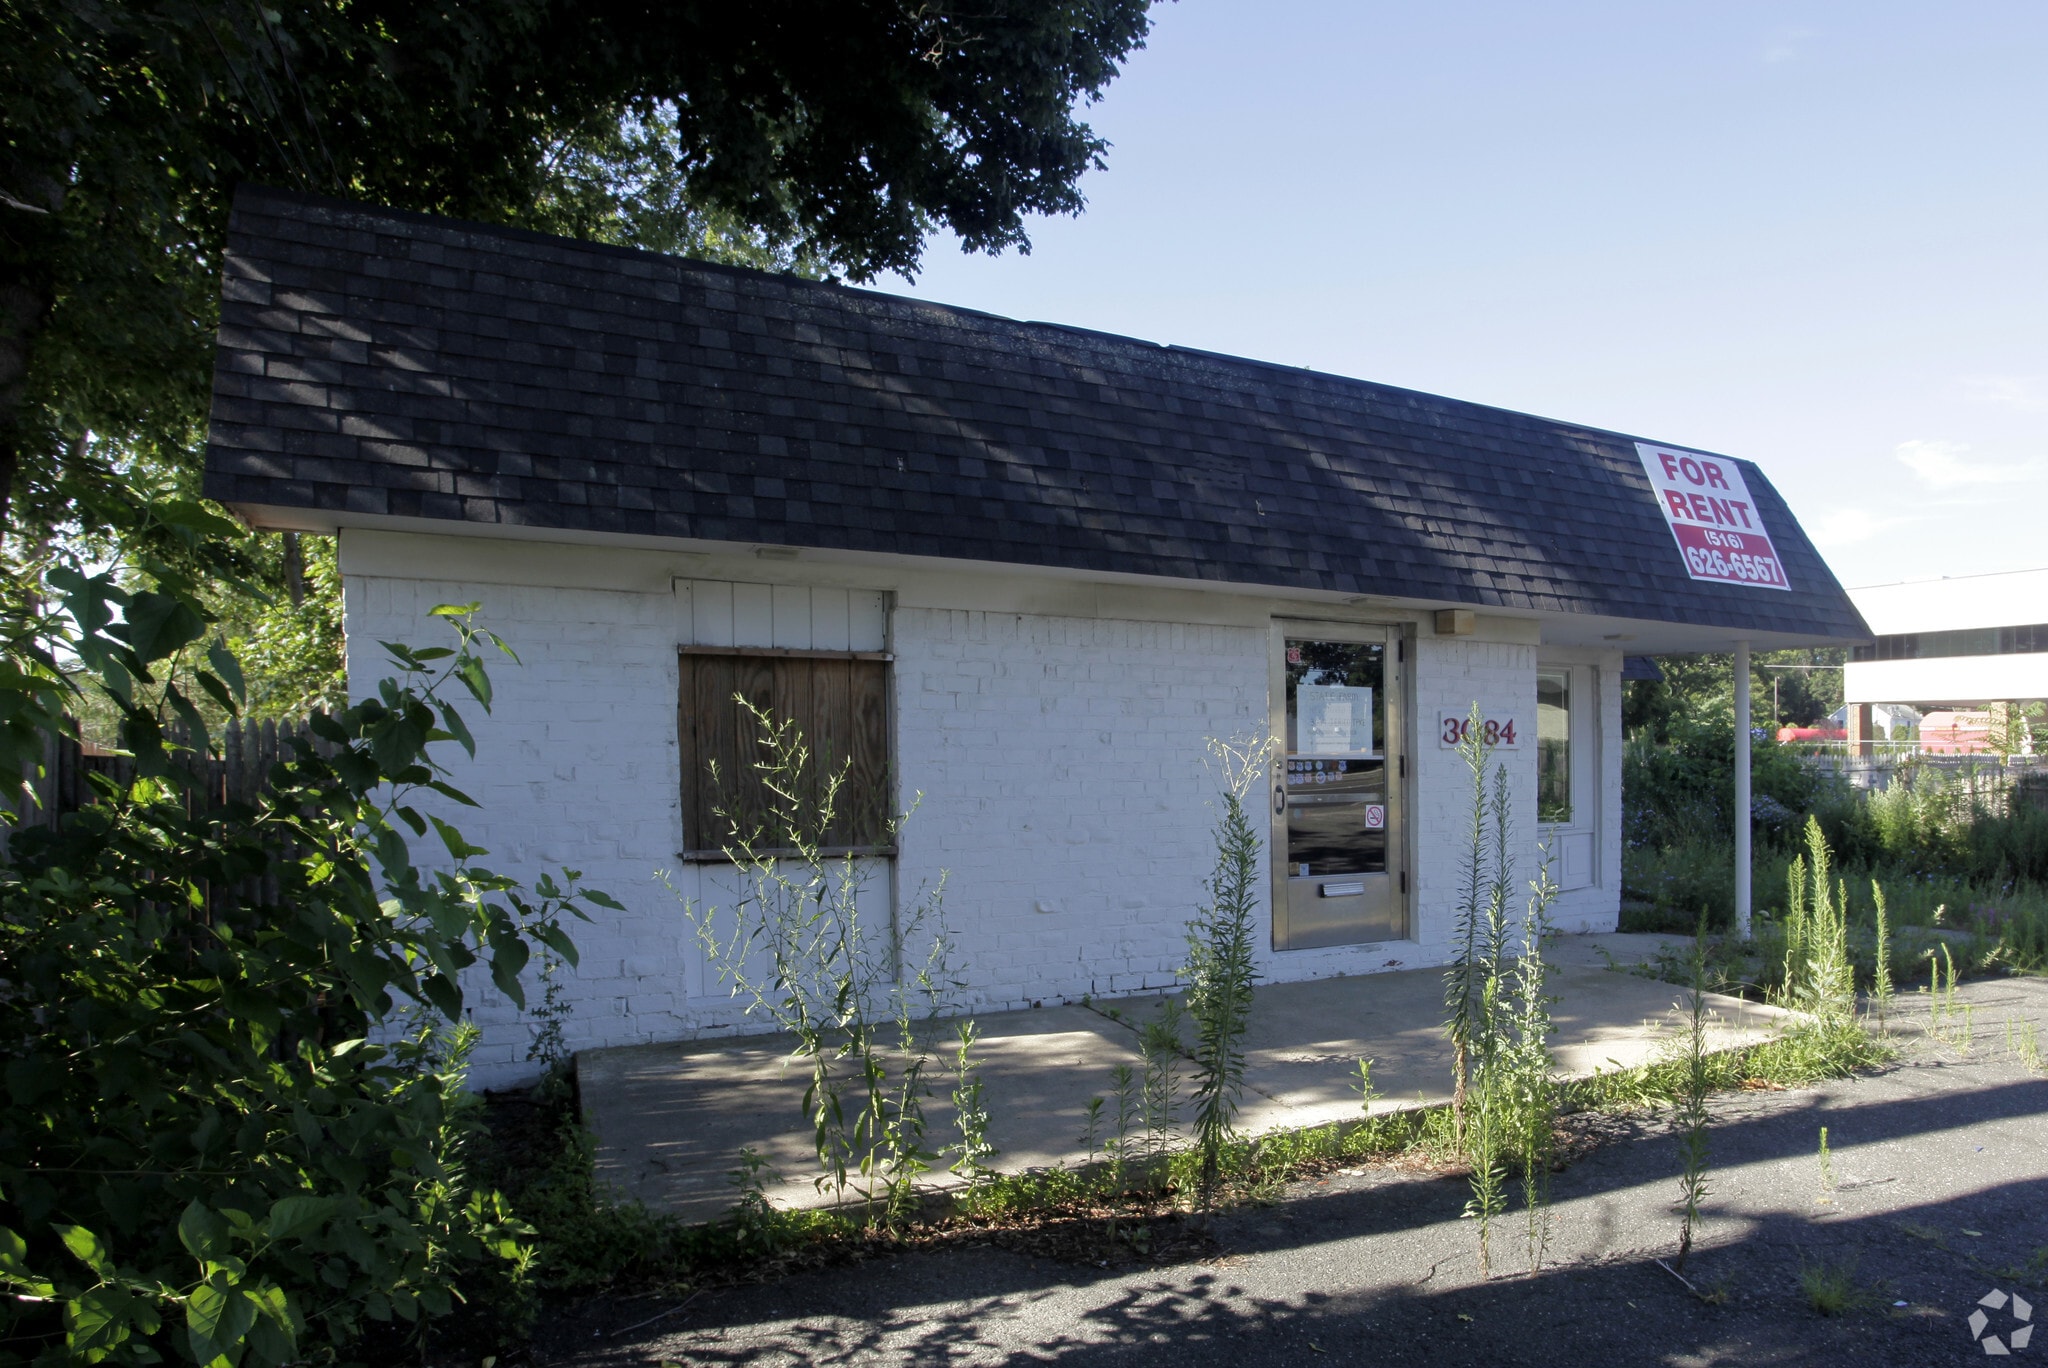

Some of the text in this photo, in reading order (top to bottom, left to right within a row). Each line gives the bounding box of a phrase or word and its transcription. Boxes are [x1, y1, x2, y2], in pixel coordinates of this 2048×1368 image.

[1657, 453, 1731, 491] FOR
[1663, 489, 1752, 529] RENT
[1704, 530, 1744, 550] (516)
[1686, 546, 1780, 583] 626-6567
